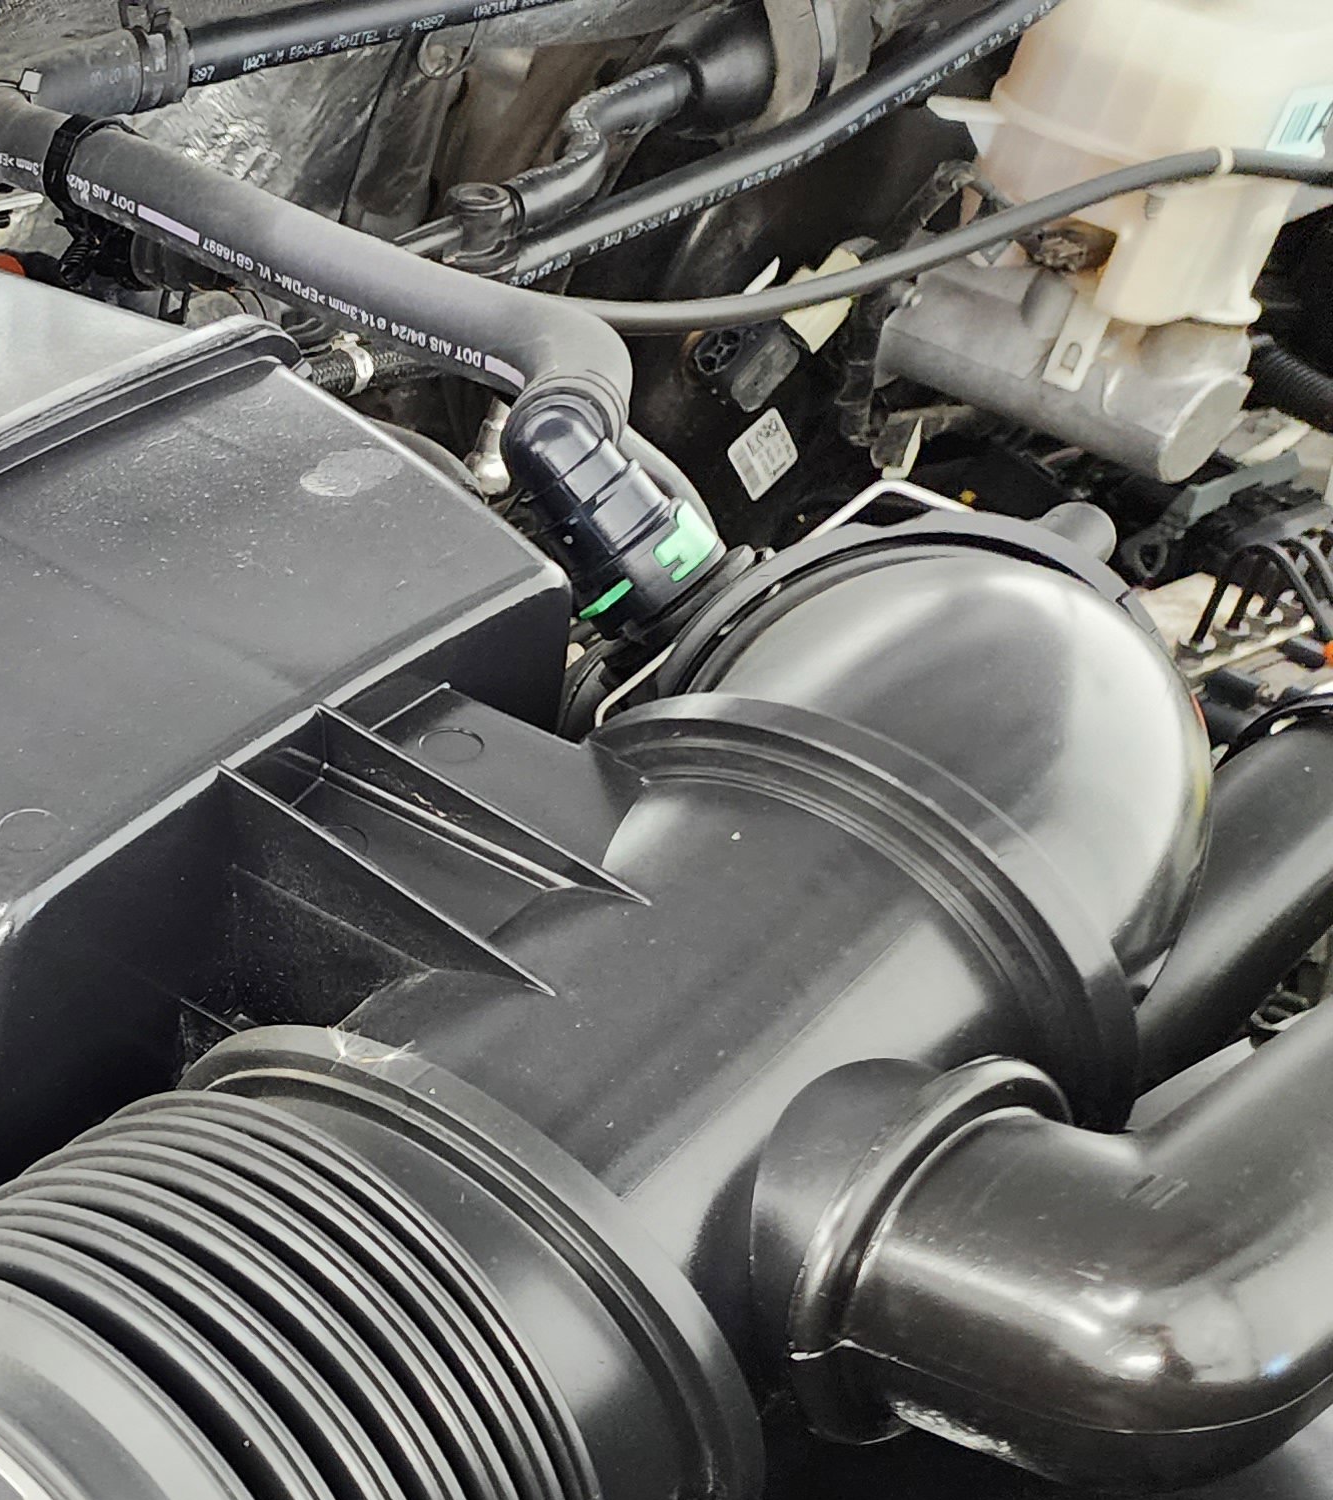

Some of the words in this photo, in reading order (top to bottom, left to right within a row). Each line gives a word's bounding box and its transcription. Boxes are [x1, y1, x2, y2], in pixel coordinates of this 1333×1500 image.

[109, 191, 138, 213] DOT
[200, 236, 256, 271] GB16897
[252, 261, 275, 281] VL
[387, 321, 429, 347] 04/24
[425, 335, 453, 356] A/S
[451, 344, 486, 368] DOT
